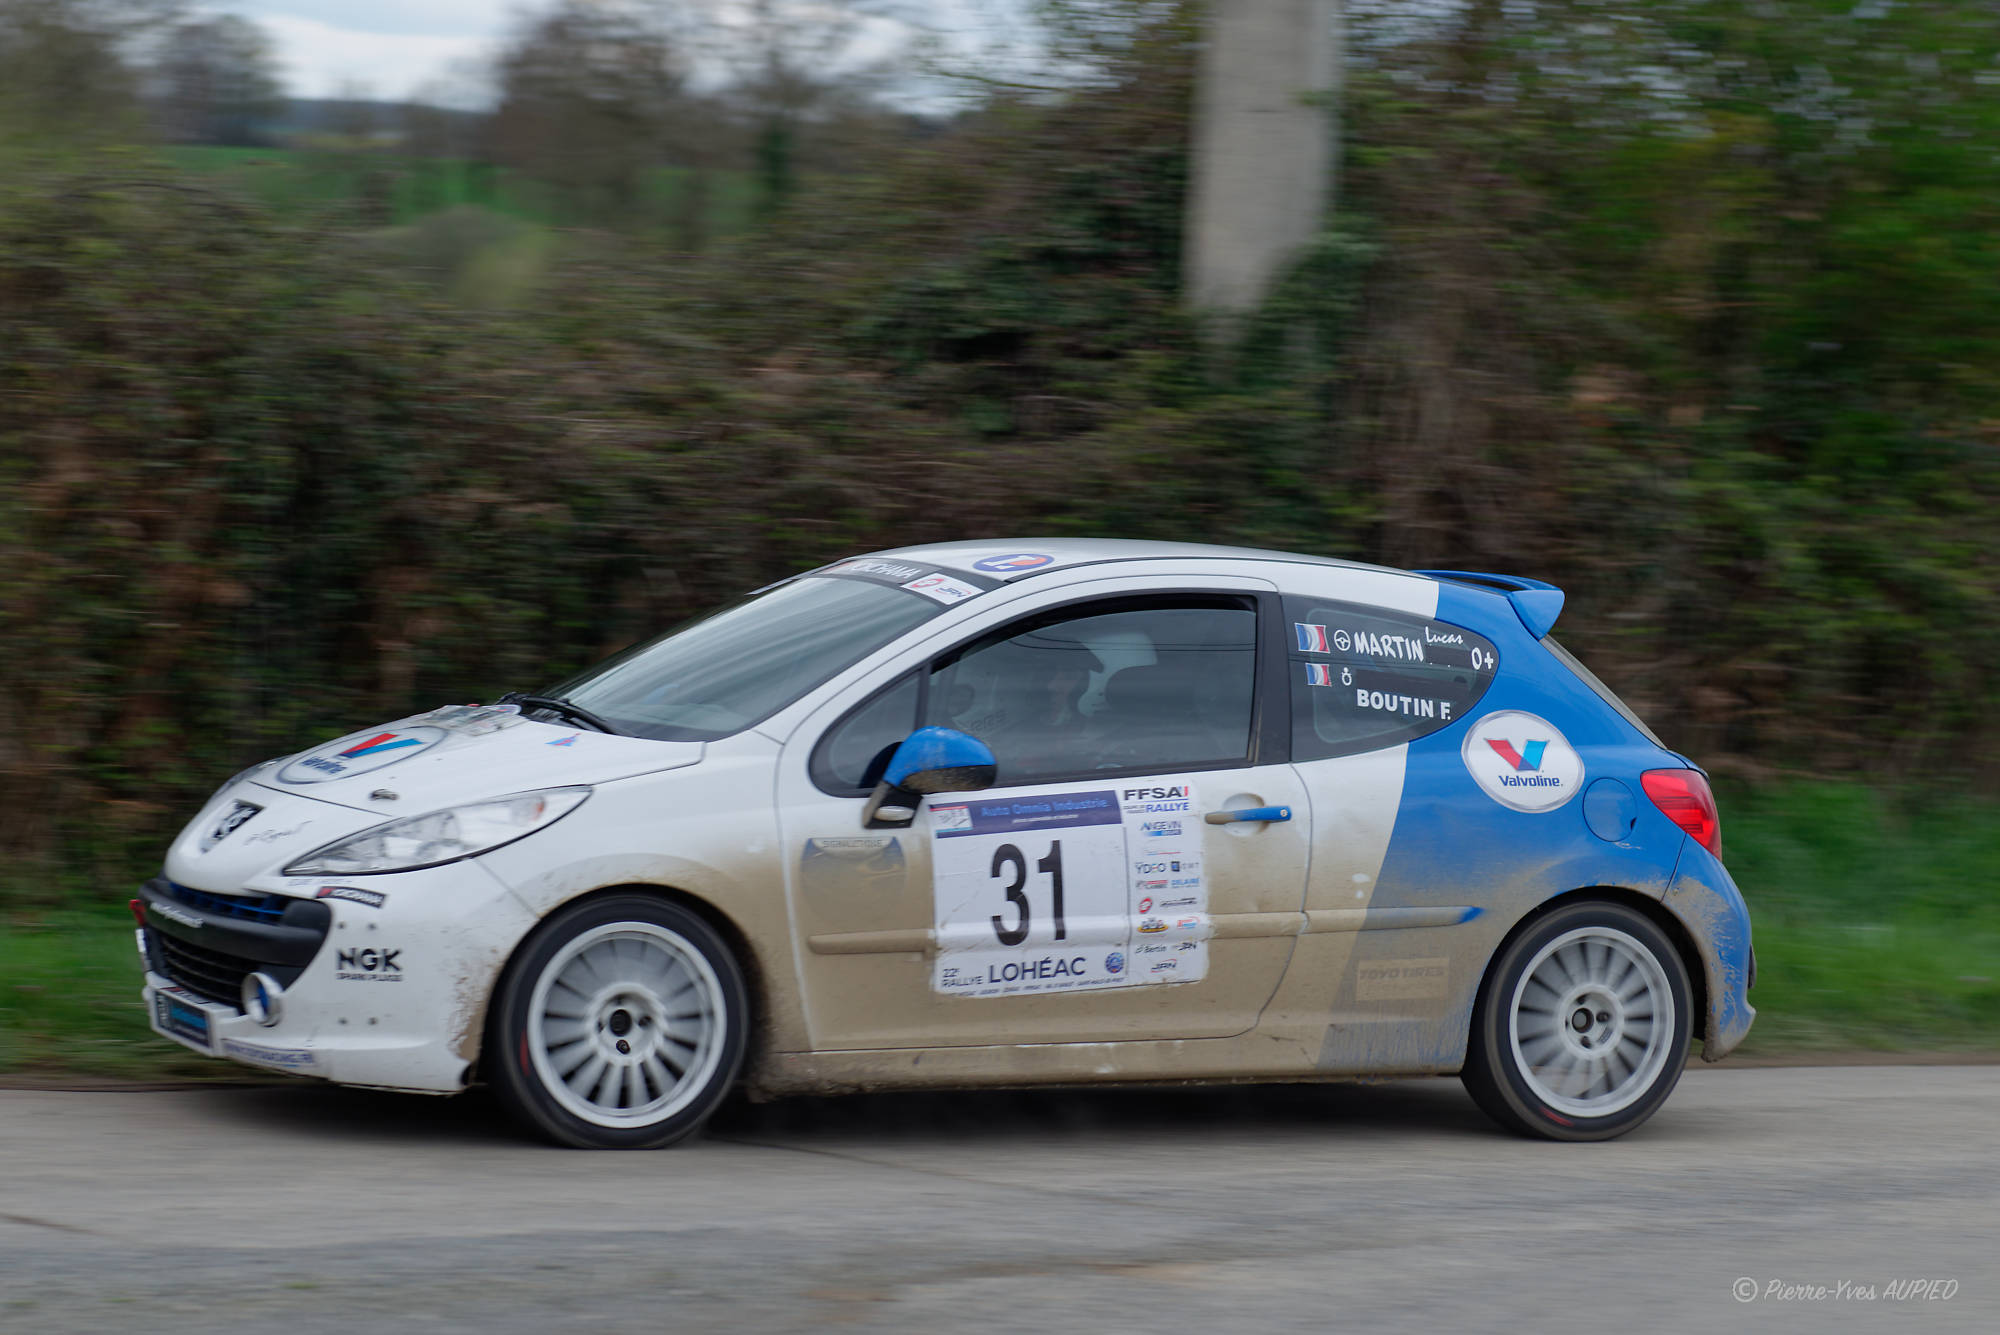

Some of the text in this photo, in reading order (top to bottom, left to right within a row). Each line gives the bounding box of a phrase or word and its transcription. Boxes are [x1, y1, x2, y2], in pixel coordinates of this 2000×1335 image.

[1354, 631, 1424, 662] MARTIN
[1425, 626, 1464, 645] Lucas
[1357, 689, 1452, 720] BOUTIN F.
[1499, 775, 1560, 787] Valvoline
[1124, 786, 1182, 801] FFSA
[1146, 802, 1189, 813] RALLYE
[991, 840, 1066, 946] 31
[337, 948, 403, 971] NGK
[989, 957, 1086, 983] LOHÉAC
